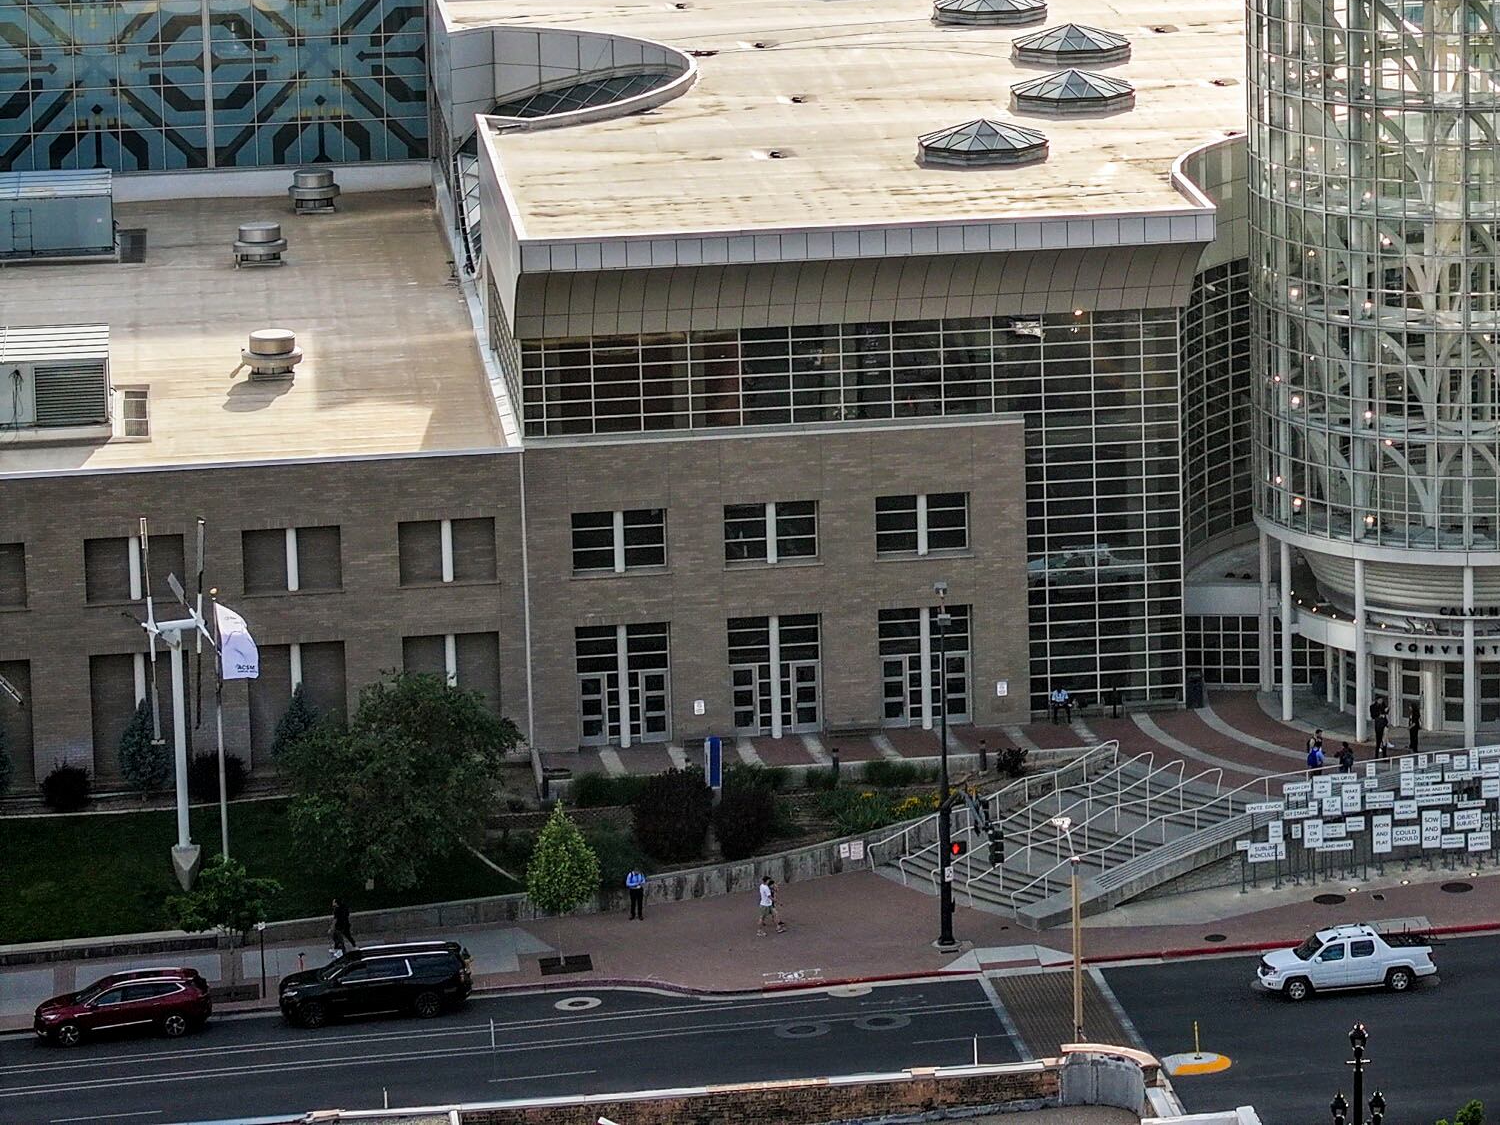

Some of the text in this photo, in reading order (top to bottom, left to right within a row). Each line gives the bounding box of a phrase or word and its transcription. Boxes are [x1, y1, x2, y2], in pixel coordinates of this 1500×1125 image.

[1440, 607, 1499, 616] CALVIN
[1457, 813, 1478, 821] OBJECT
[1394, 835, 1419, 843] SHOULD
